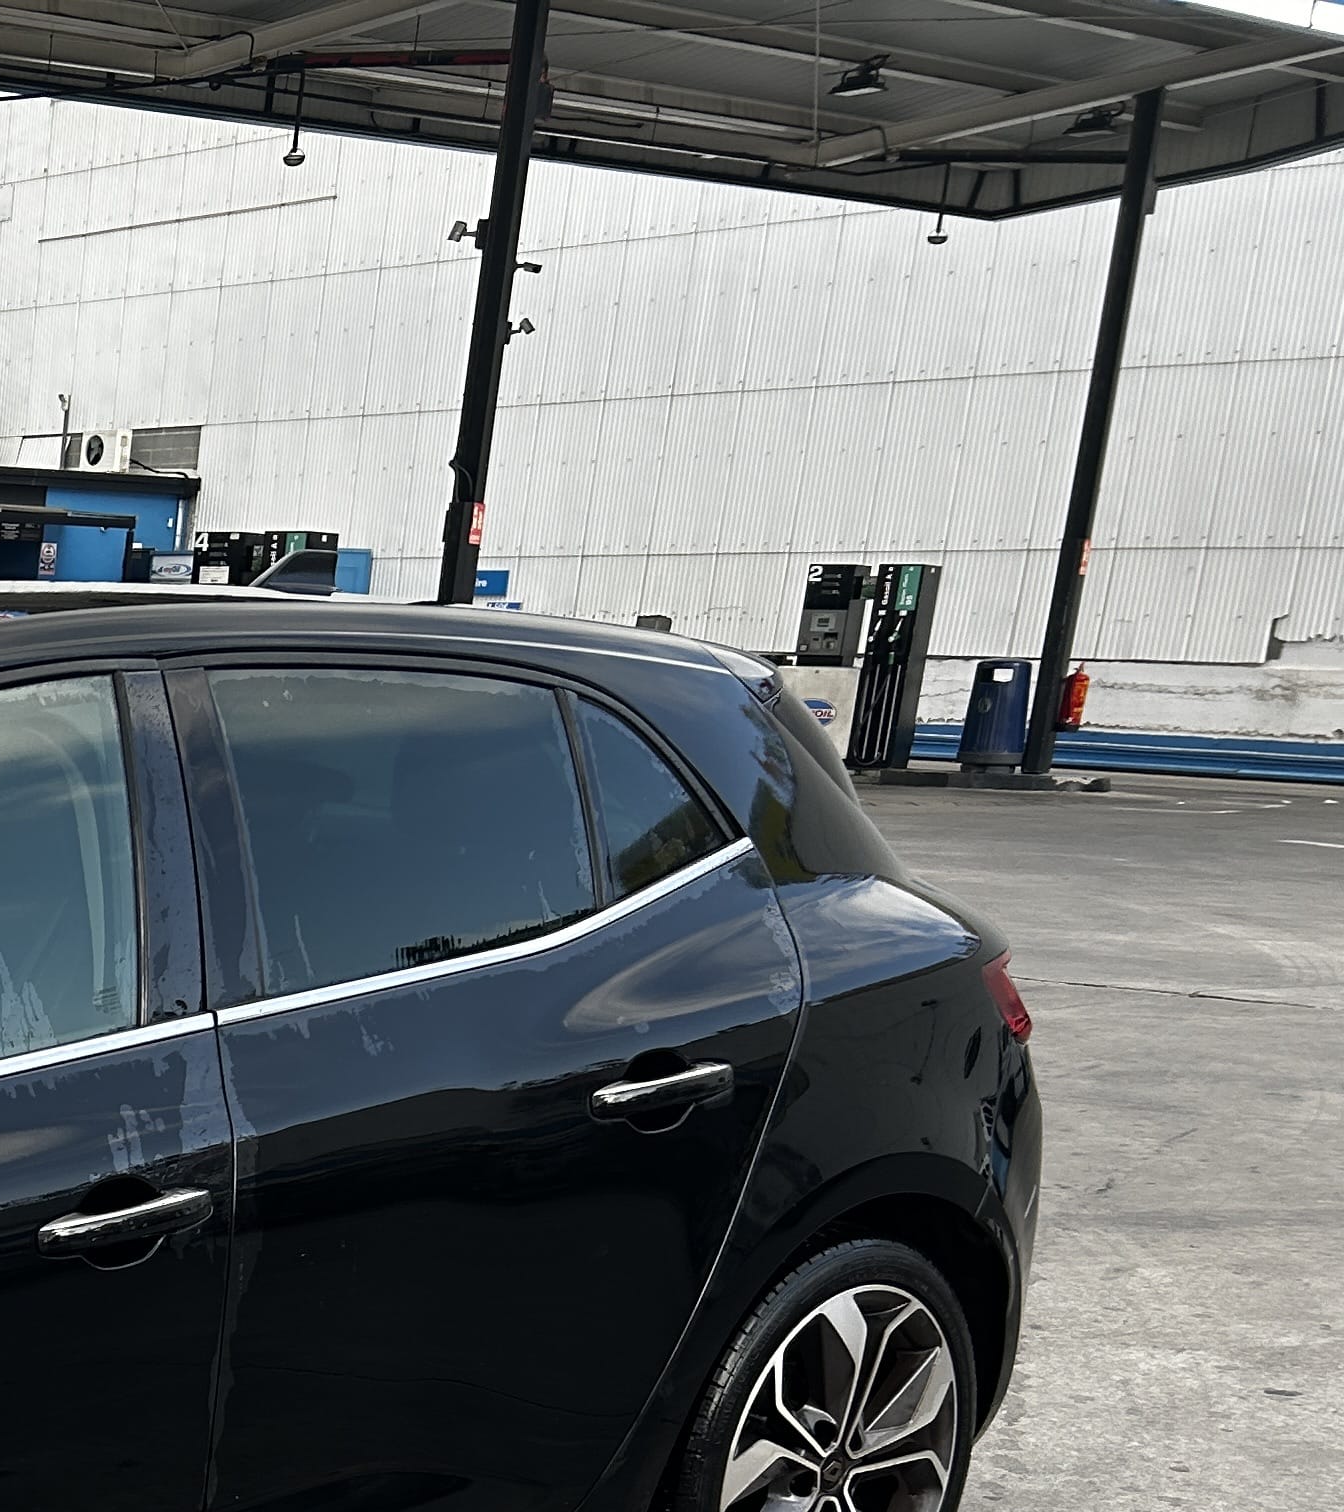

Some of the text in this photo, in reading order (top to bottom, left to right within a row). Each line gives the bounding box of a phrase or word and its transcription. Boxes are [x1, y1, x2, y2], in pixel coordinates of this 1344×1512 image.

[195, 533, 209, 551] 4
[808, 566, 824, 582] 2
[813, 709, 834, 719] OIL
